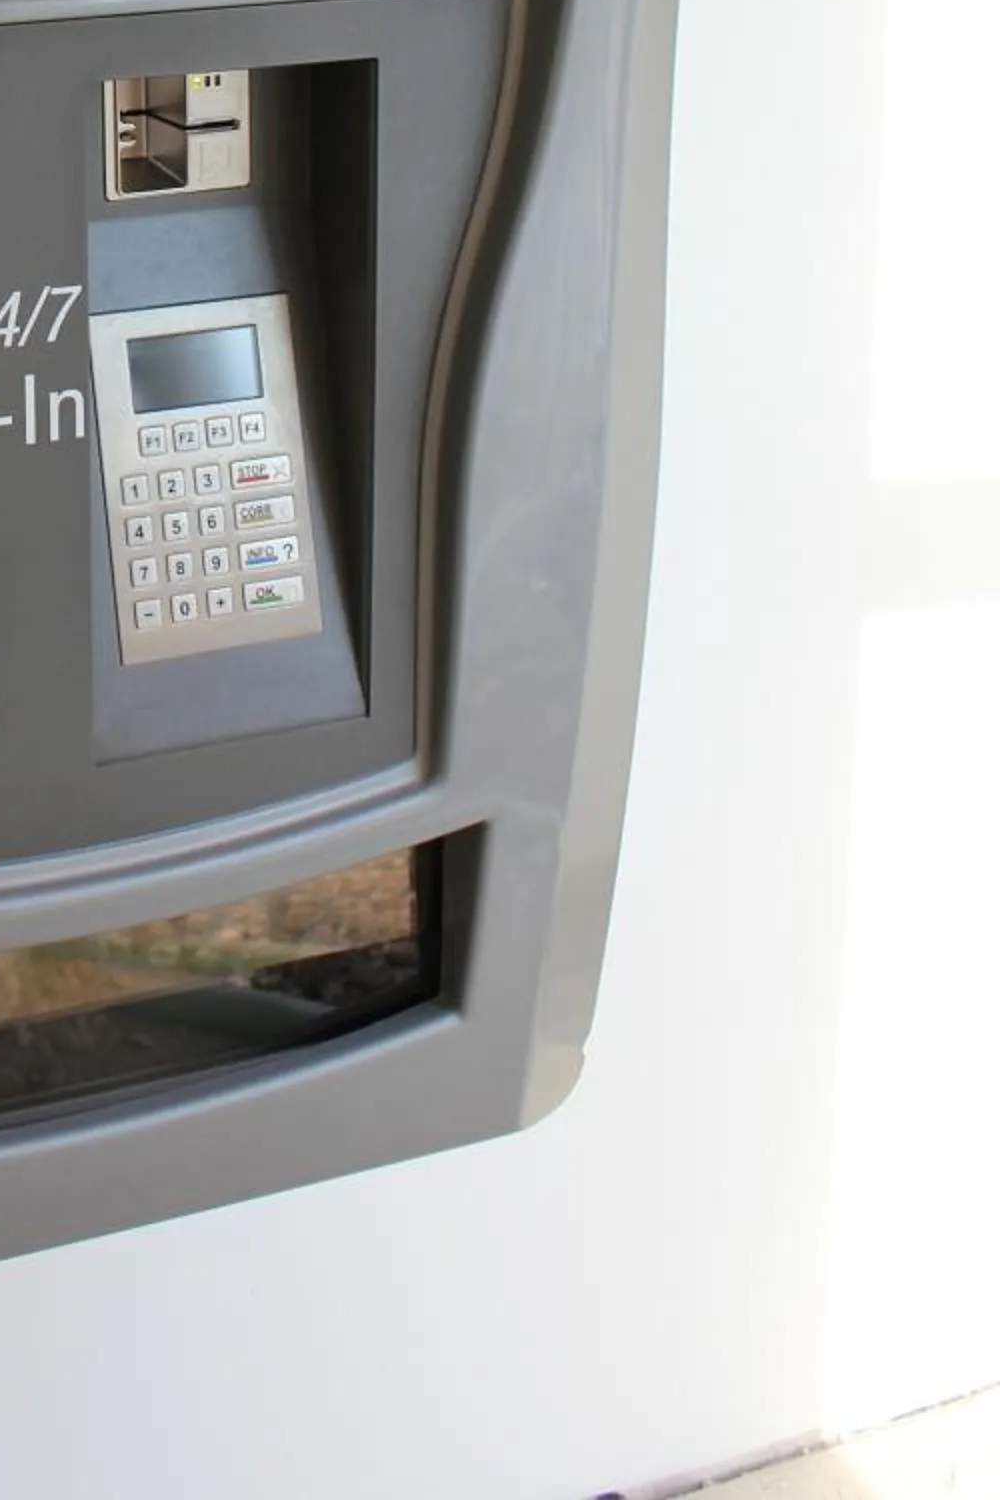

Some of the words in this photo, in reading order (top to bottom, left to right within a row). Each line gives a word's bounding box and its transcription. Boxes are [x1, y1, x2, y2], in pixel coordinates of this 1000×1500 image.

[179, 430, 195, 444] F2
[211, 426, 227, 439] F3
[245, 422, 260, 435] F4
[131, 483, 139, 498] 1
[167, 478, 177, 493] 2
[203, 473, 213, 488] 3
[236, 464, 266, 477] STOP
[135, 524, 145, 539] 4
[171, 519, 181, 535] 5
[207, 514, 217, 530] 6
[139, 565, 149, 581] 7
[175, 560, 185, 576] 8
[211, 555, 221, 571] 9
[179, 600, 190, 617] 0
[255, 584, 276, 599] OK
